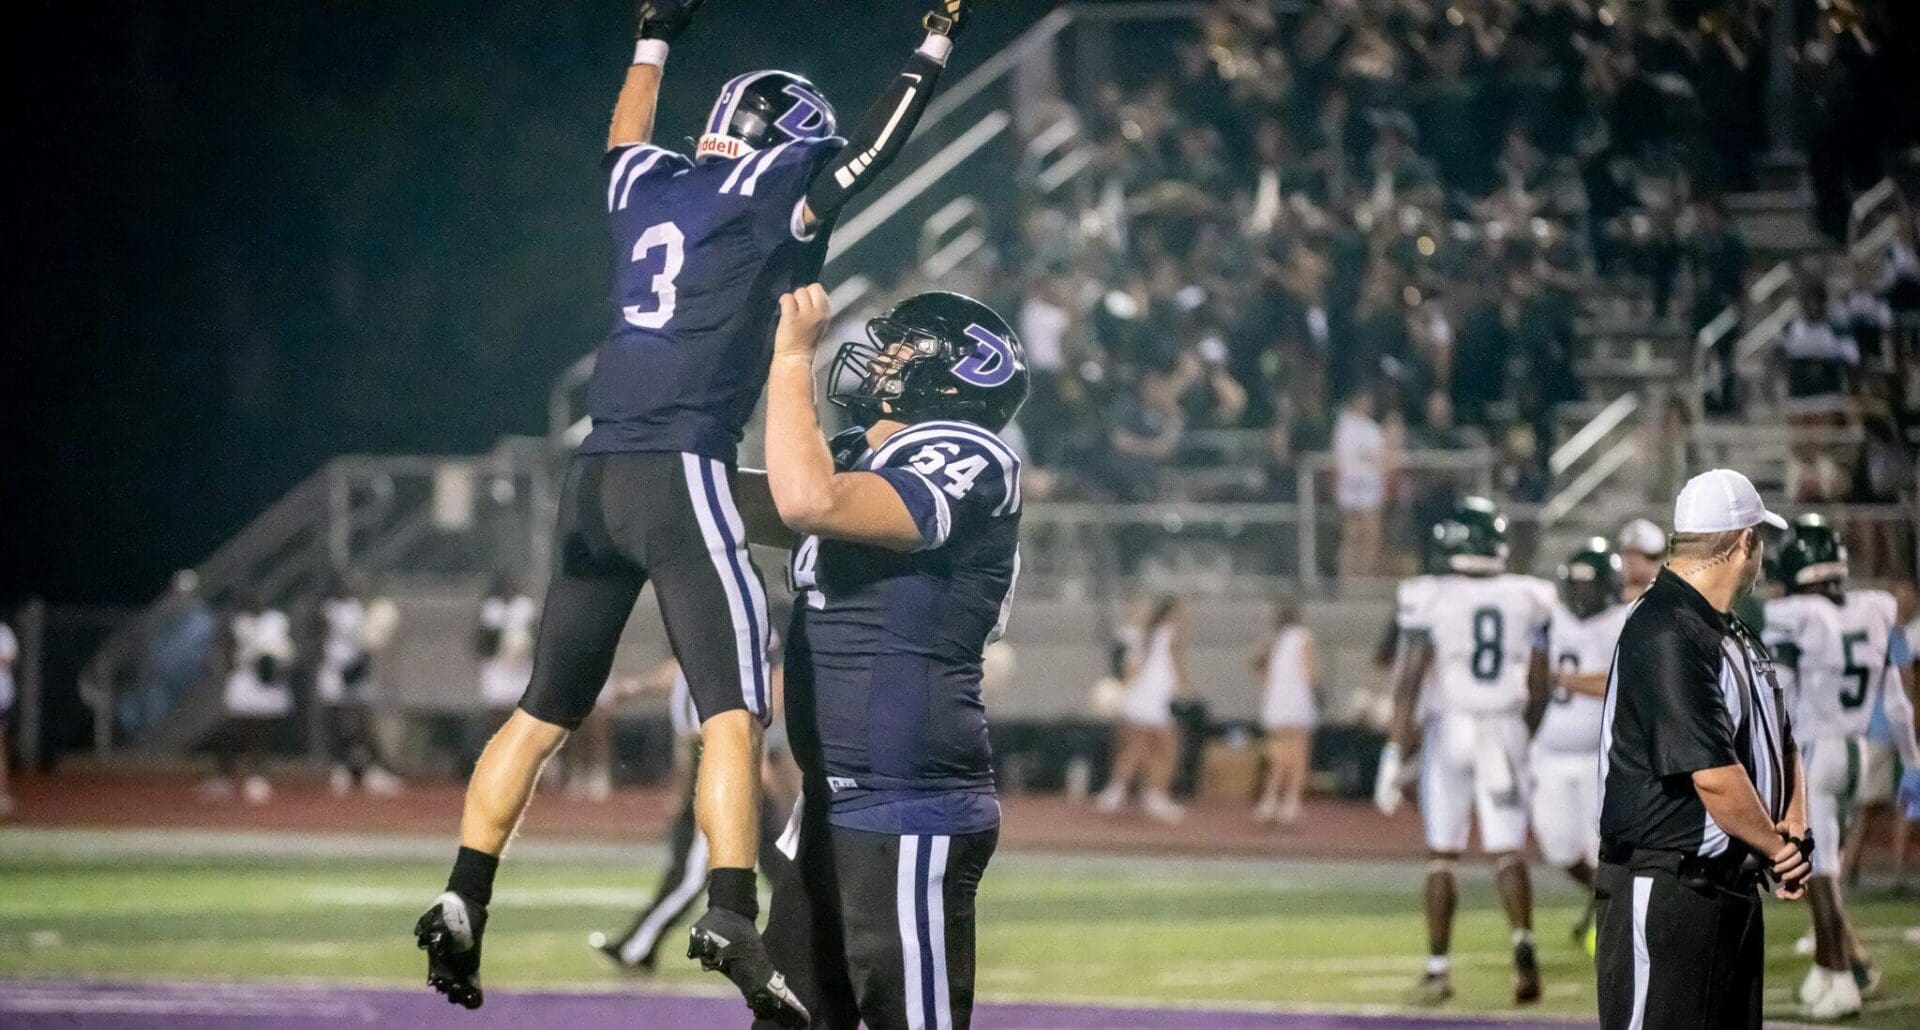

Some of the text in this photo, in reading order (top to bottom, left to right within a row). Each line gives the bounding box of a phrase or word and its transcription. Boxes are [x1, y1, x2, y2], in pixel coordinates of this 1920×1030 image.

[700, 137, 739, 156] ddell
[623, 221, 685, 329] 3
[951, 323, 1015, 387] D
[908, 441, 989, 500] 64
[1472, 607, 1503, 681] 8
[1840, 630, 1868, 707] 5
